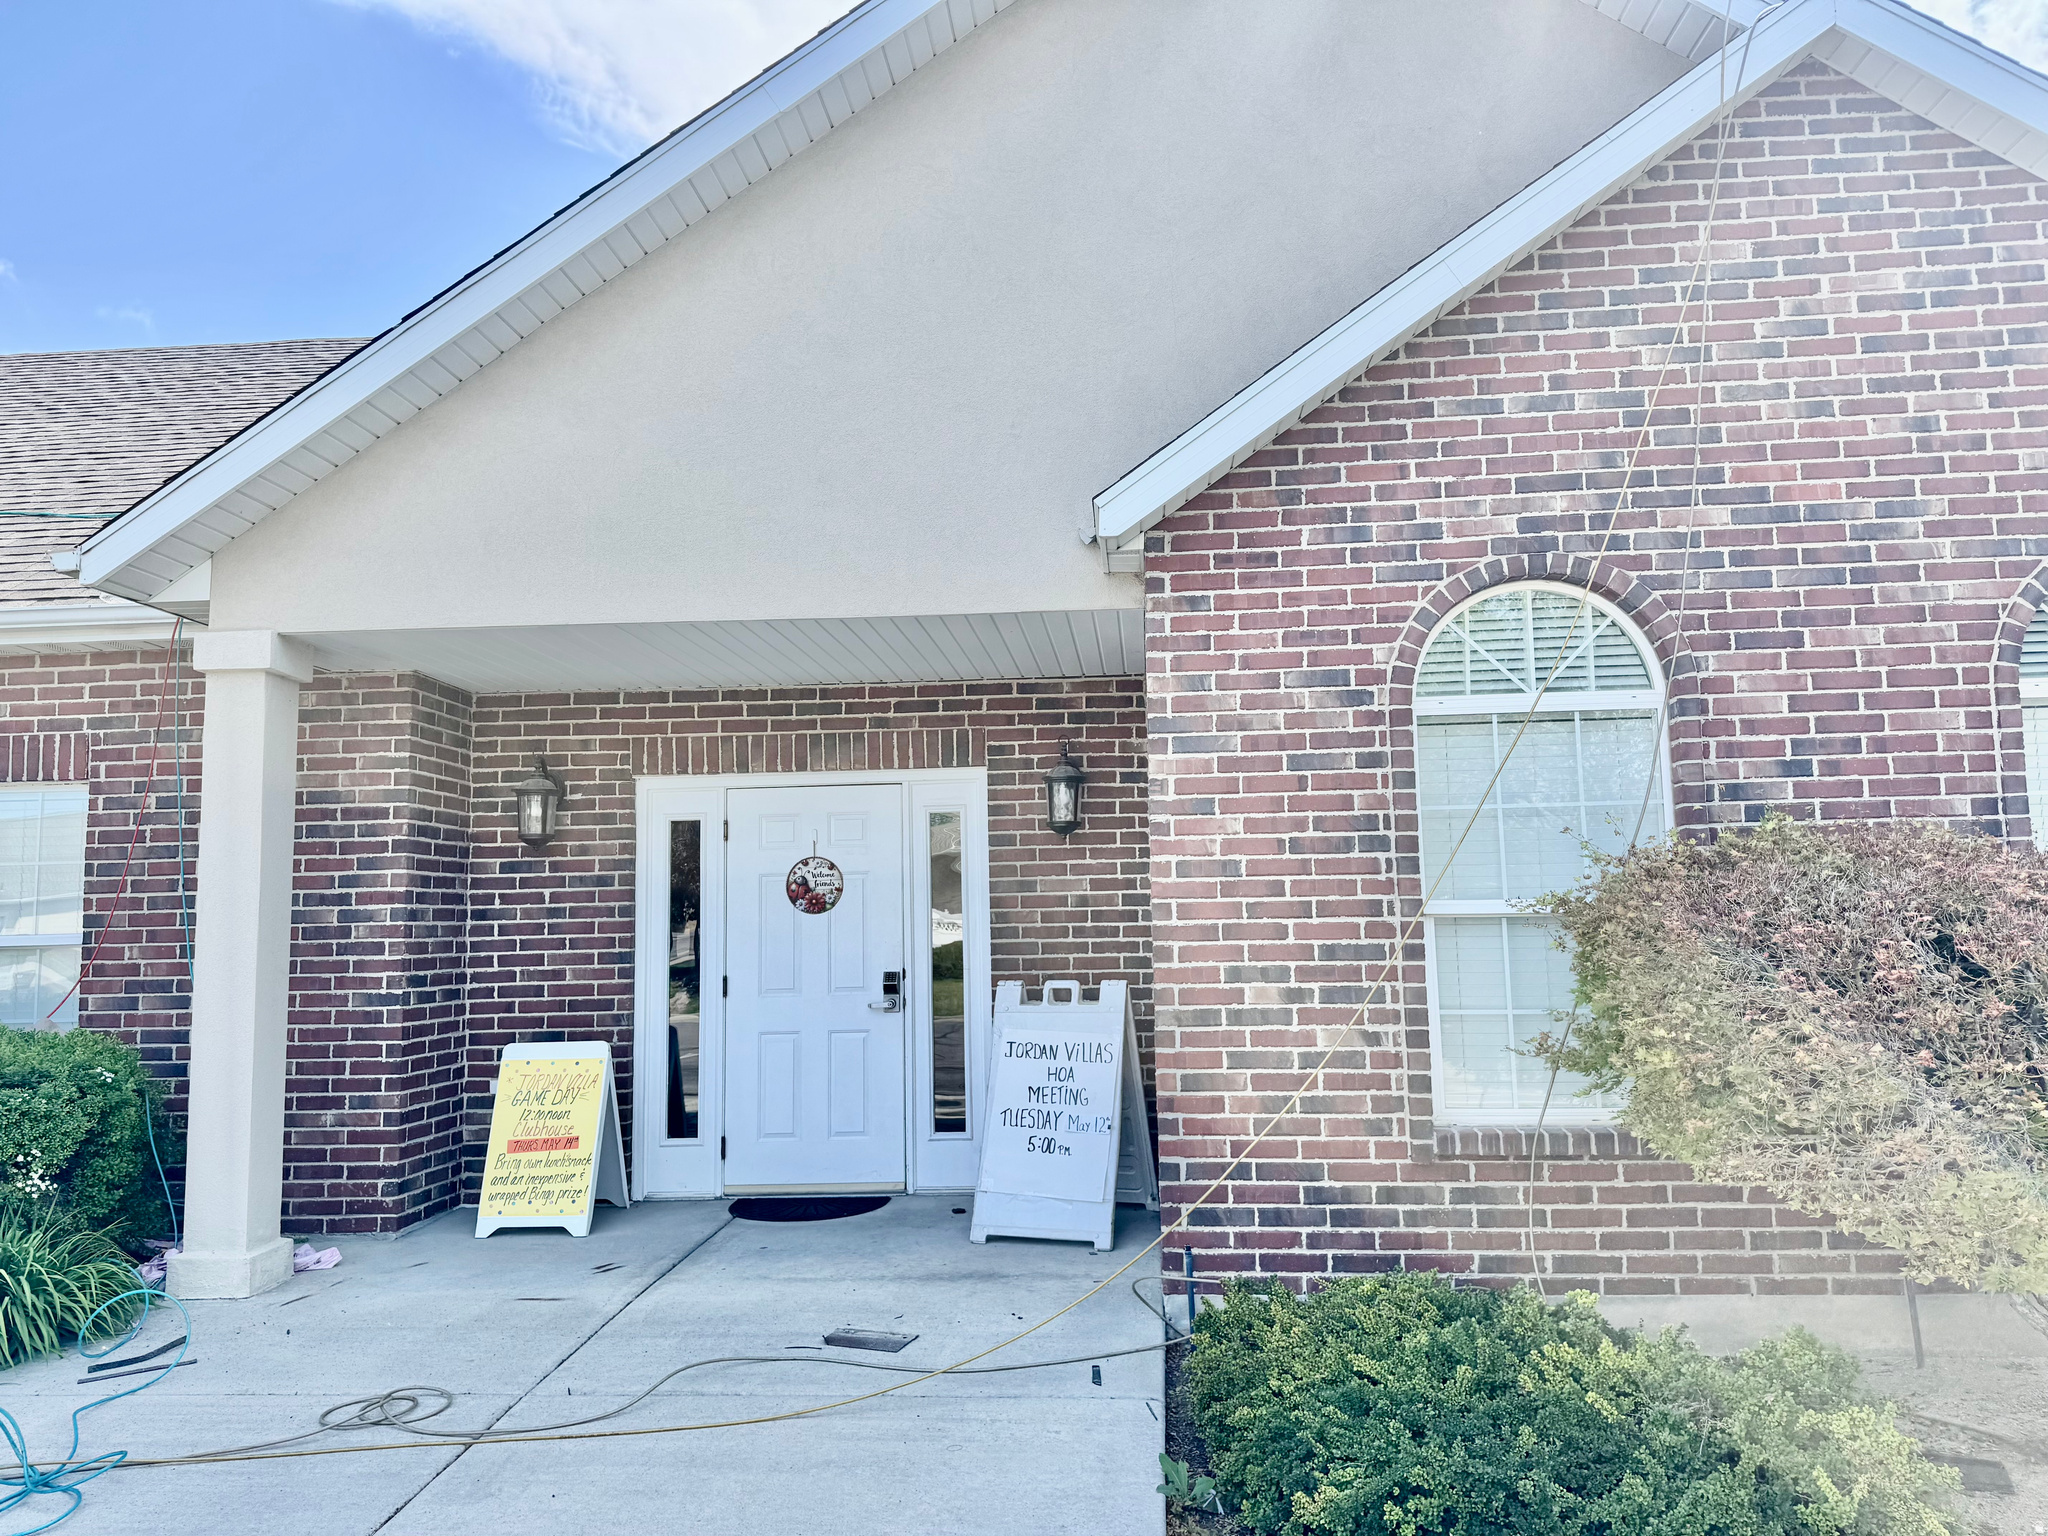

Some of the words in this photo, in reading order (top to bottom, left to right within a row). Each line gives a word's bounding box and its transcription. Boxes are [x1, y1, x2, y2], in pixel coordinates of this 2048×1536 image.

[811, 871, 836, 879] Welcome
[814, 879, 836, 888] friends
[1004, 1041, 1059, 1060] JORDAN
[515, 1073, 568, 1090] JORDAN
[567, 1073, 600, 1090] VILLA
[1047, 1066, 1075, 1083] HOA
[511, 1089, 551, 1106] GAME
[551, 1087, 581, 1105] DAY
[512, 1121, 574, 1137] Clubhouse
[999, 1107, 1064, 1131] TUESDAY
[1068, 1114, 1091, 1132] May
[540, 1137, 562, 1150] MAY
[1027, 1135, 1056, 1154] 5:00
[494, 1152, 522, 1174] Bring
[523, 1158, 543, 1169] own
[490, 1171, 511, 1186] and
[510, 1174, 524, 1185] an
[525, 1170, 576, 1189] inexpensive
[488, 1186, 529, 1206] wrapped
[529, 1186, 555, 1206] Bingo
